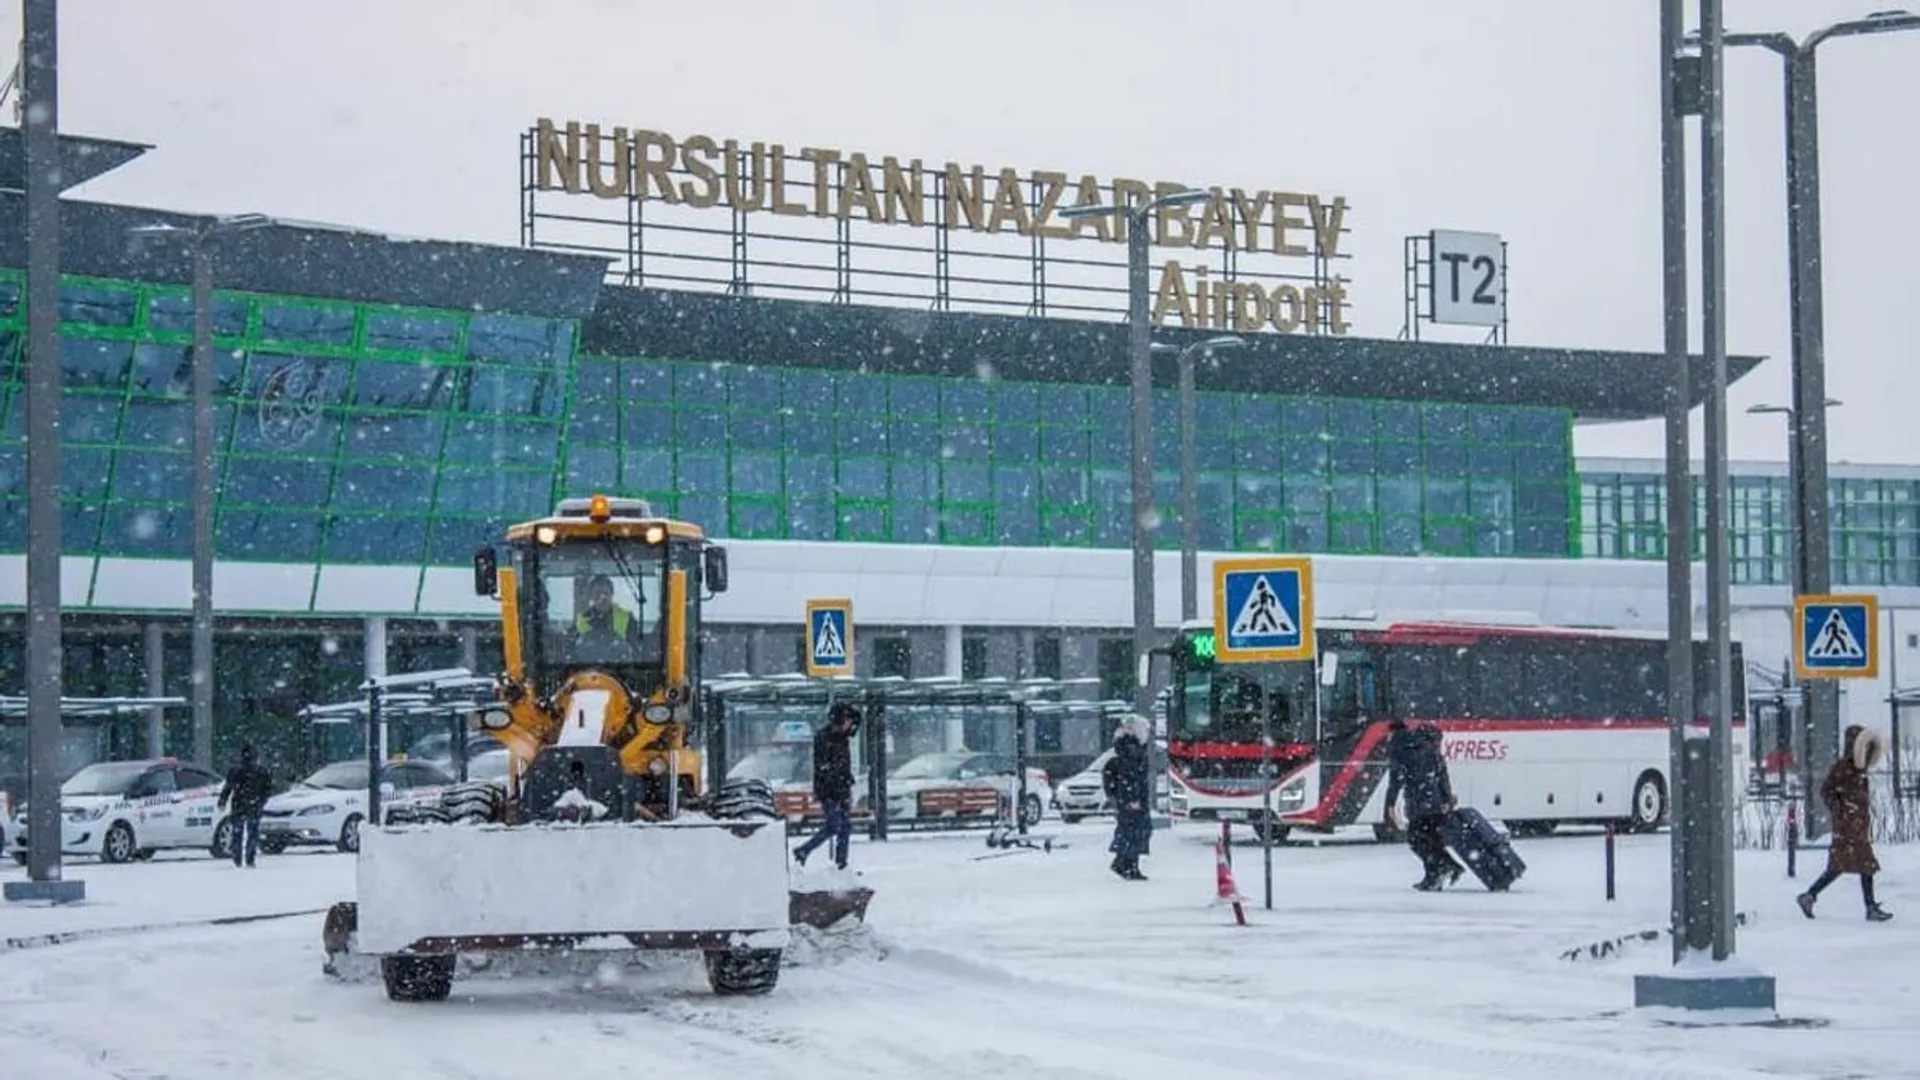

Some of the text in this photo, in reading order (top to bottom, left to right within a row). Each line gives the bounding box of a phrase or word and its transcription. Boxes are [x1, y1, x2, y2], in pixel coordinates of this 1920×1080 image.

[537, 118, 1346, 259] NURSULTAN NAZARBAYEV
[1152, 260, 1348, 334] Airport
[1440, 252, 1496, 304] T2
